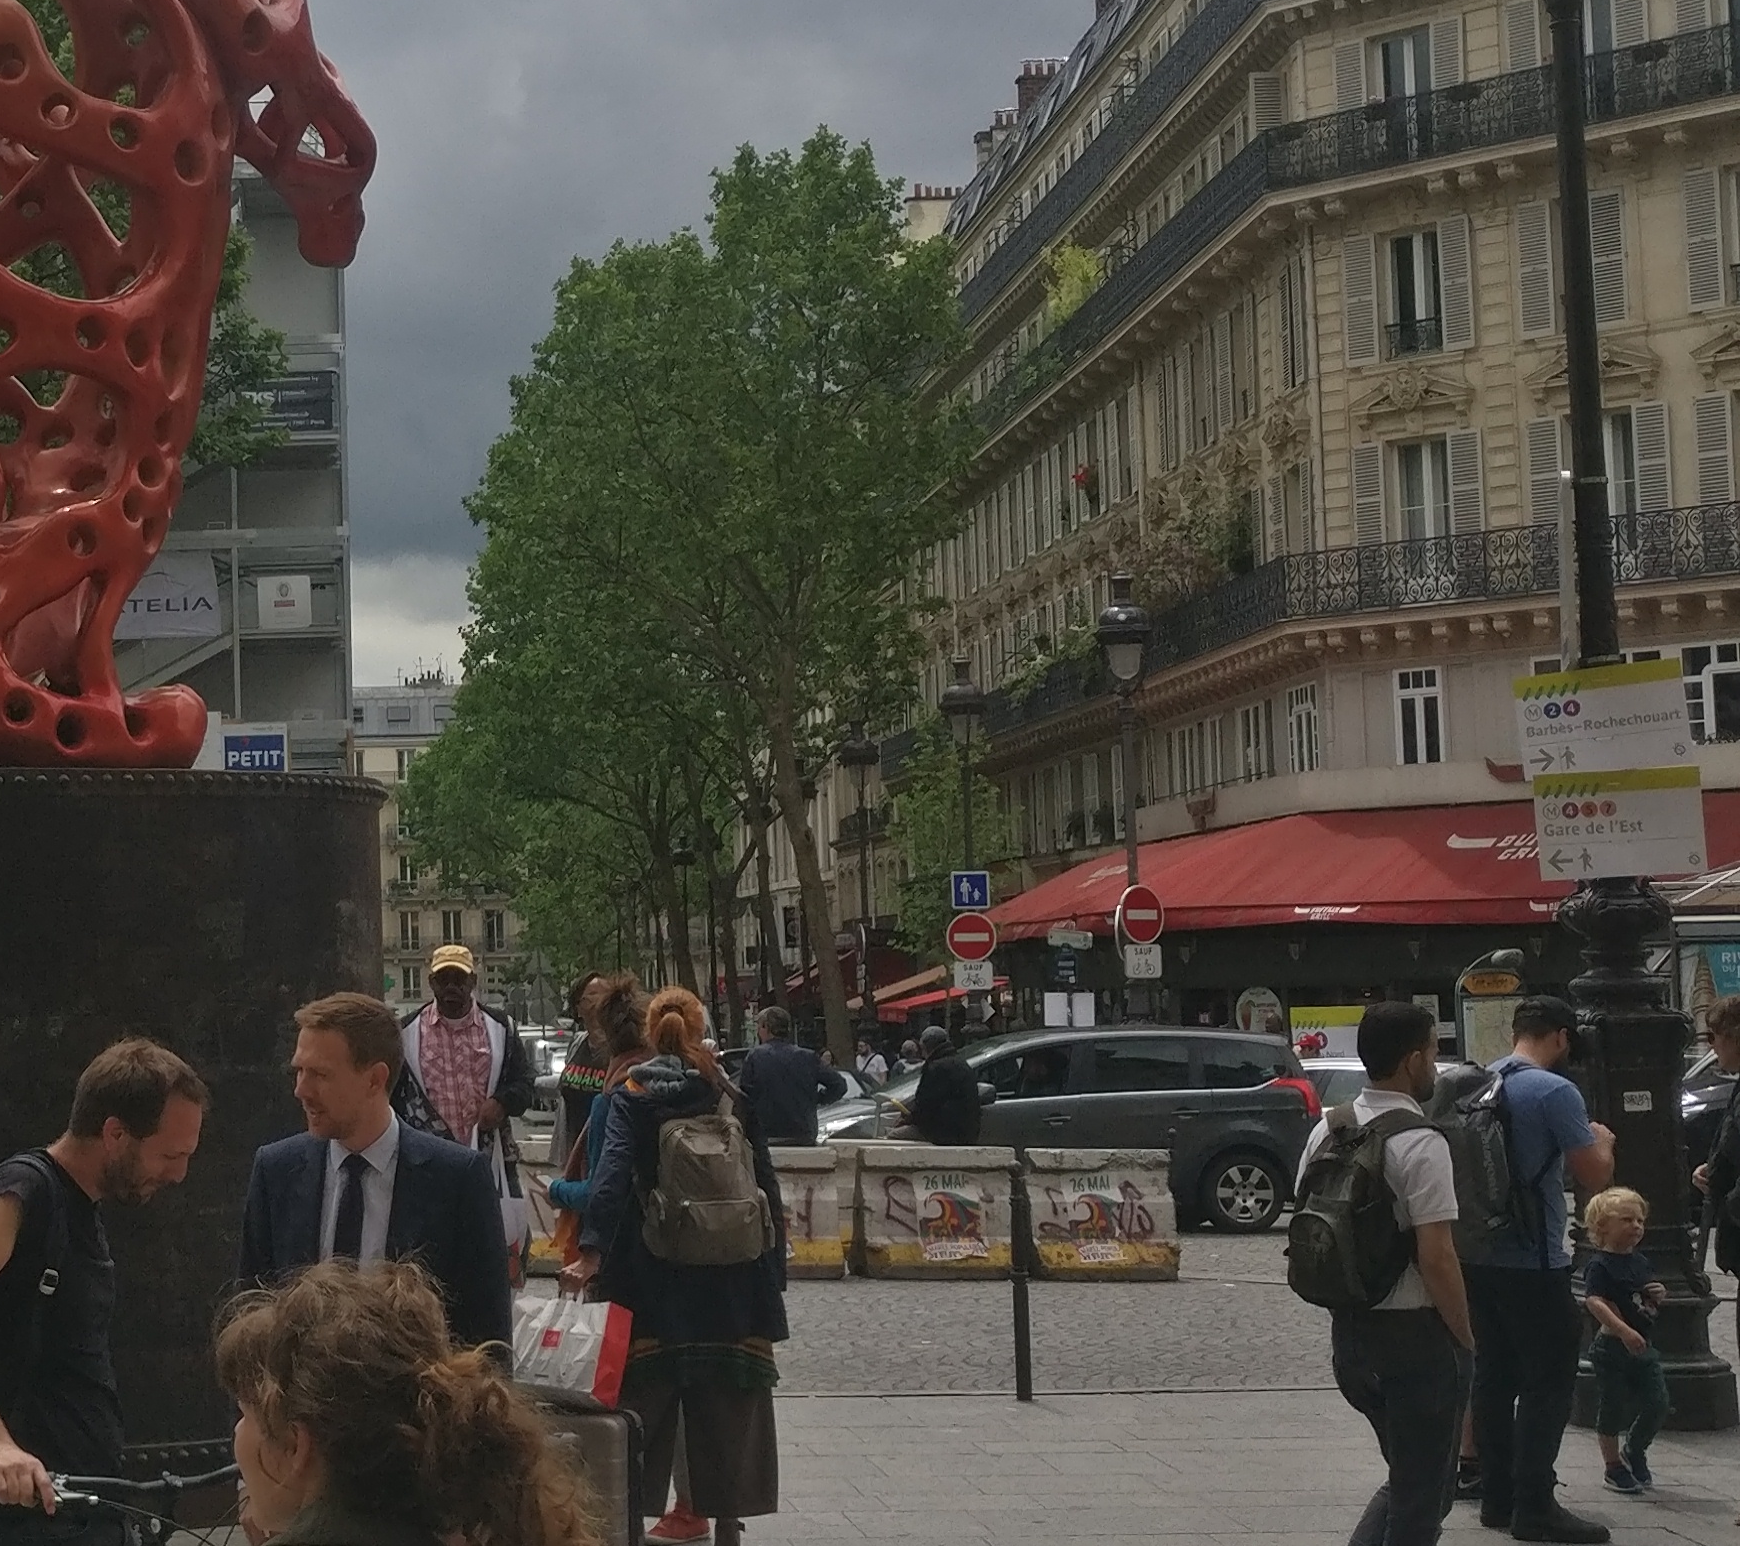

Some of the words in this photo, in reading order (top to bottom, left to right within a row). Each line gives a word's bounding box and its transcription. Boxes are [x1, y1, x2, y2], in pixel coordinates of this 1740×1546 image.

[122, 596, 213, 613] TELIA
[228, 750, 281, 767] PETIT
[1543, 823, 1580, 838] Gare
[1585, 820, 1604, 834] de
[1134, 947, 1153, 955] SAUF
[922, 1175, 939, 1191] 26
[1070, 1177, 1085, 1192] 26
[1086, 1175, 1110, 1192] MAI
